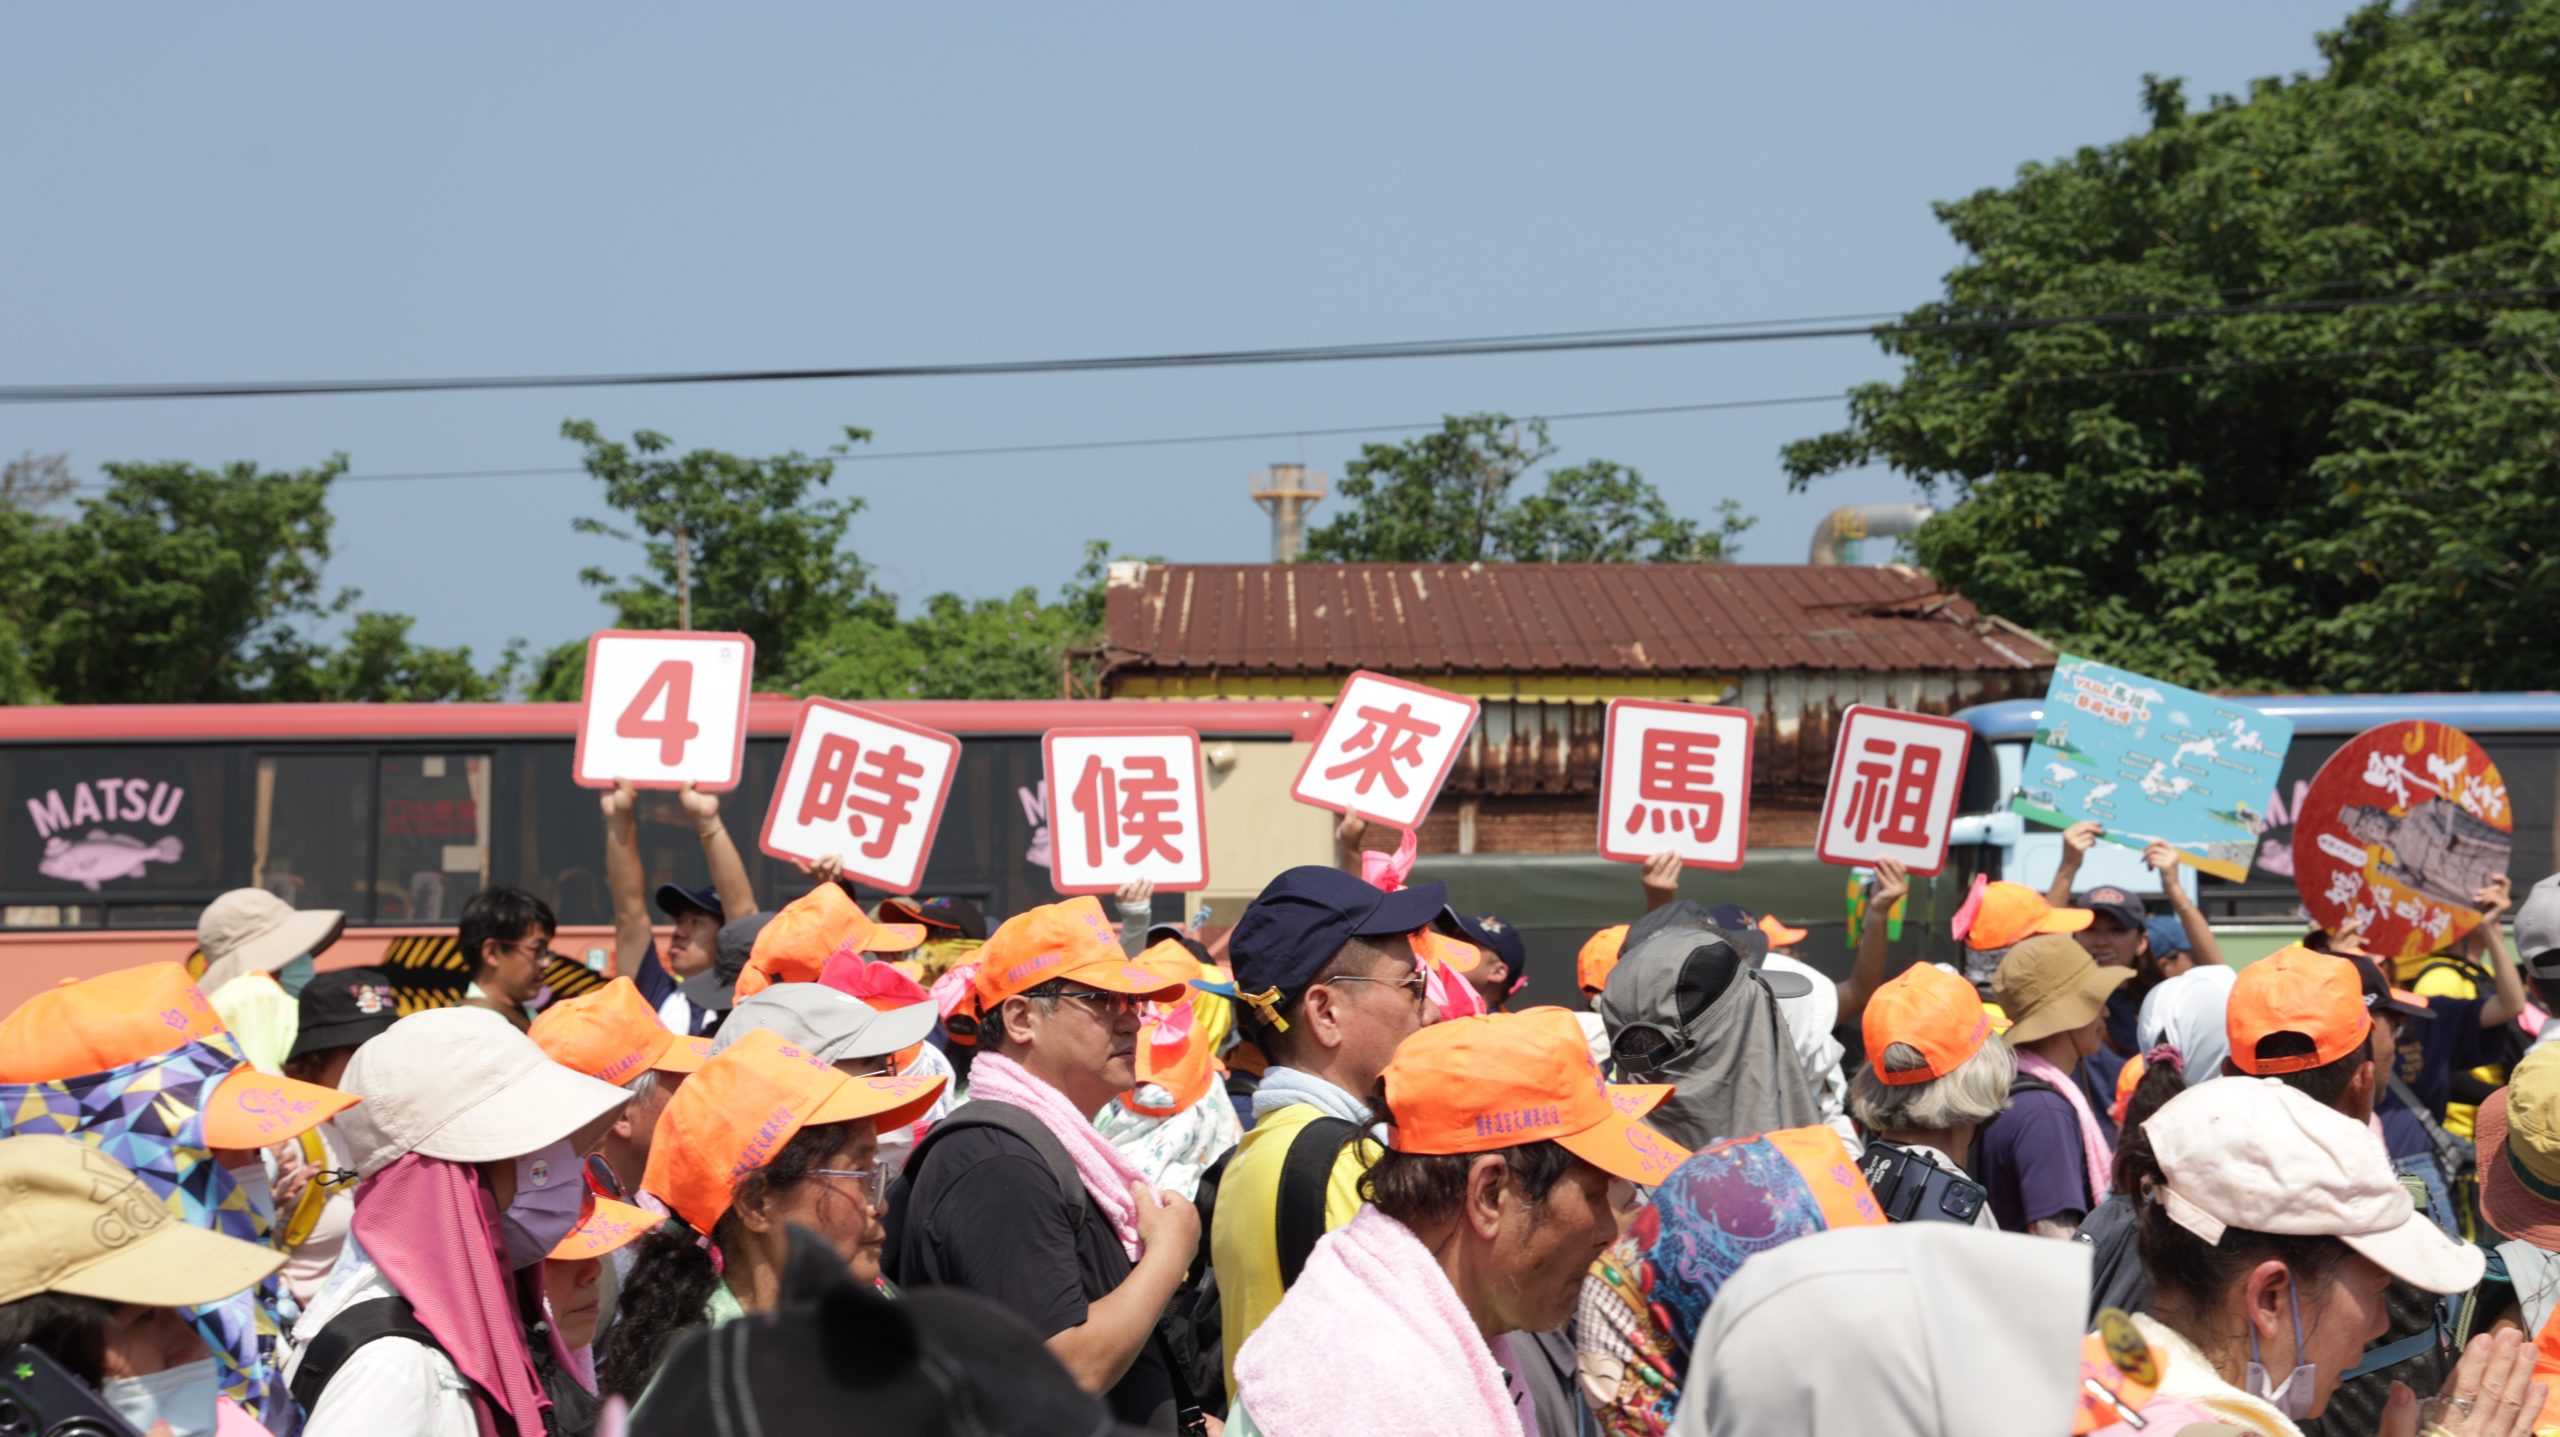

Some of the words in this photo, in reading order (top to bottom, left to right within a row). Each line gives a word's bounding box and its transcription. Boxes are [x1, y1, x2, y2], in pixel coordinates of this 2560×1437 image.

[616, 661, 699, 767] 4
[1325, 704, 1440, 799] 來
[26, 778, 184, 838] MATSU
[798, 733, 925, 859] 時
[1073, 755, 1184, 867] 候
[1626, 729, 1724, 843] 馬
[1844, 738, 1942, 848] 祖
